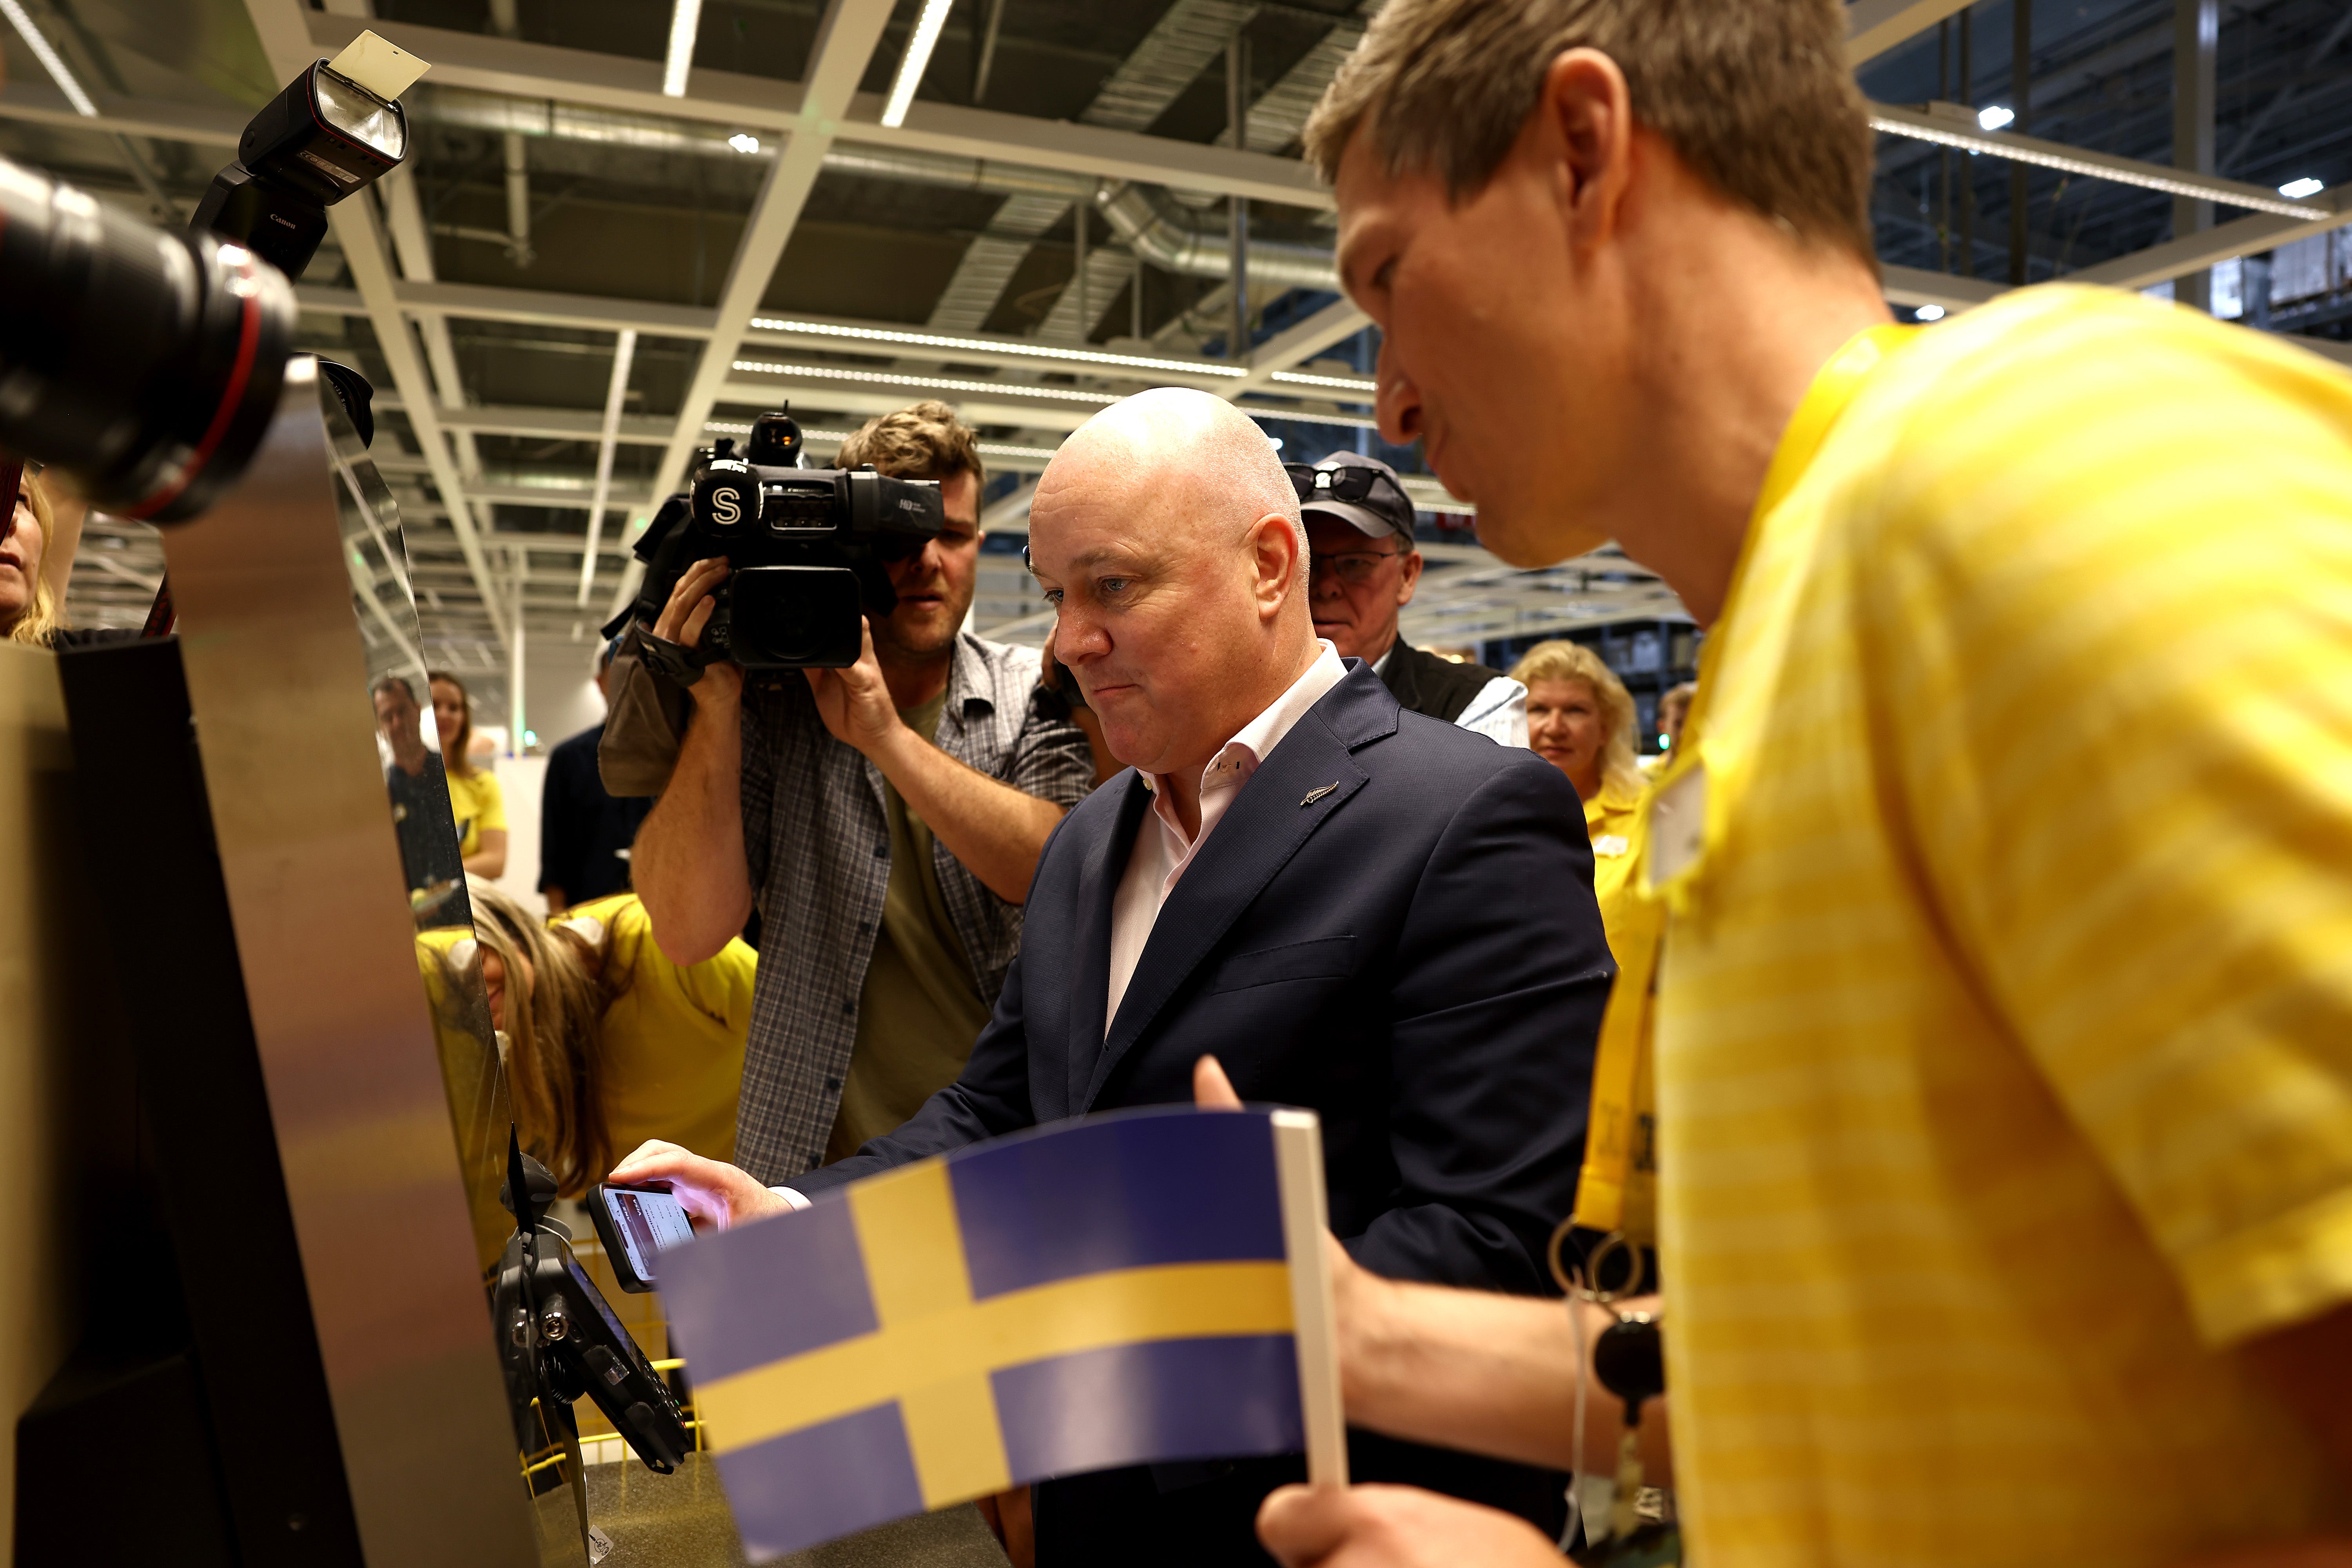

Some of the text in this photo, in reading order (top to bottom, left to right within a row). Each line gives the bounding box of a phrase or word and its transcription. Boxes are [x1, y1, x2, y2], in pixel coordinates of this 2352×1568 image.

[270, 214, 296, 229] Canon
[712, 487, 741, 525] S
[622, 1207, 632, 1222] ANZ
[632, 1199, 642, 1217] VISA
